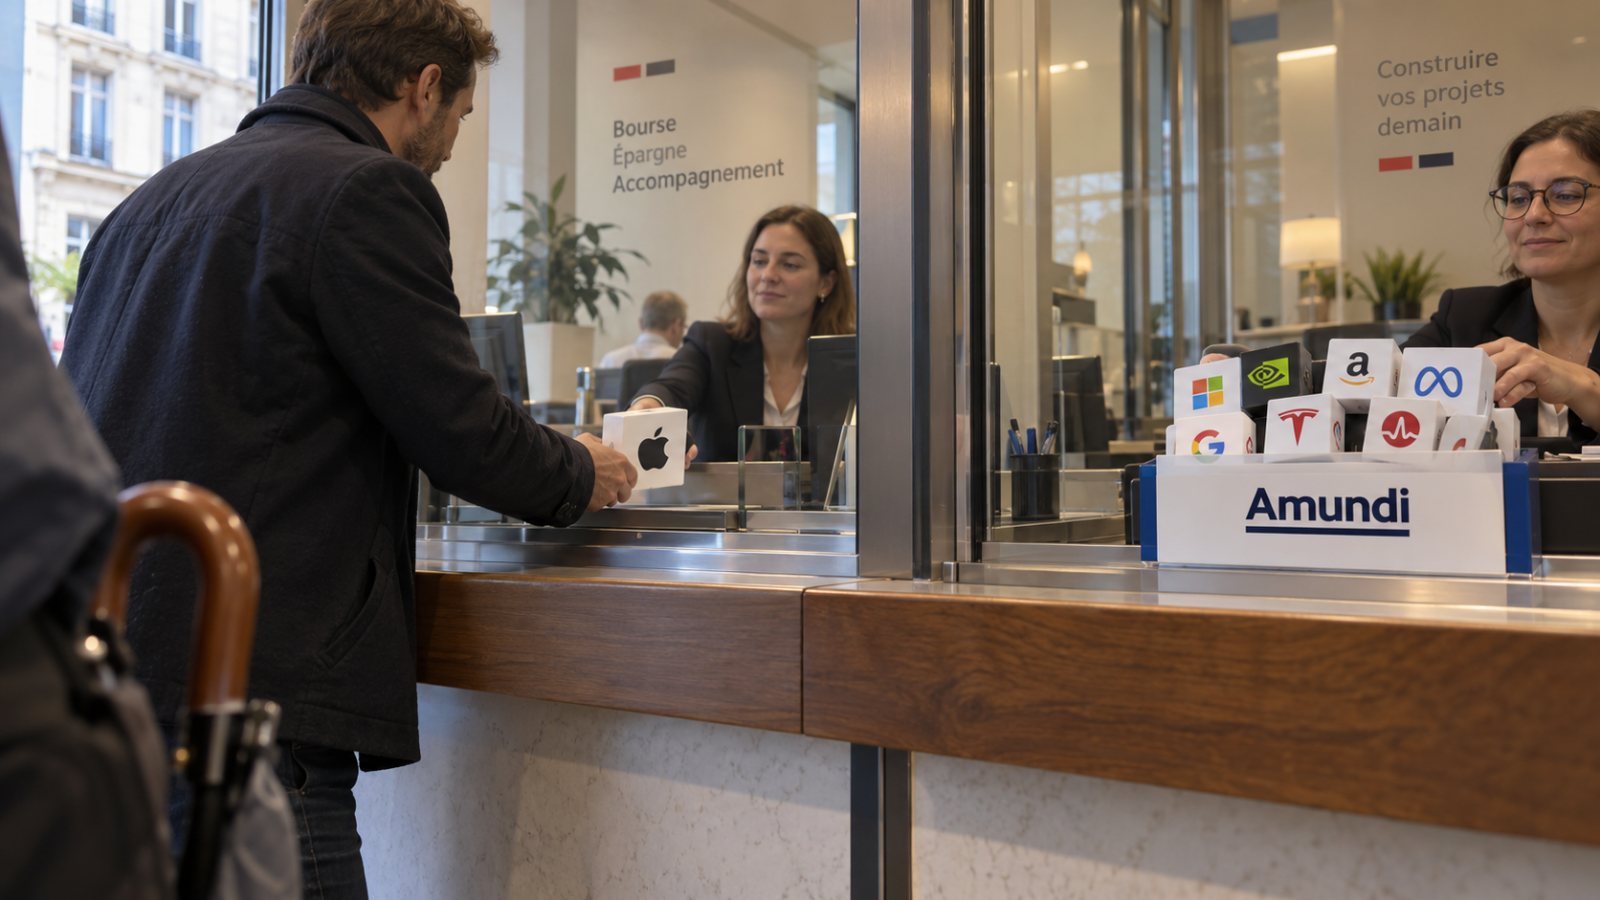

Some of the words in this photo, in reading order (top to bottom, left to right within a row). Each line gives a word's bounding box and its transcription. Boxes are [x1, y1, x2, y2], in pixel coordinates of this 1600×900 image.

[1377, 50, 1499, 79] Construire
[1377, 90, 1416, 107] vos
[1423, 79, 1505, 108] projets
[613, 117, 677, 138] Bourse
[1377, 112, 1462, 136] demain
[613, 143, 687, 169] Épargne
[612, 158, 784, 194] Accompagnement
[1346, 351, 1369, 377] a
[1191, 429, 1225, 463] G
[1245, 487, 1410, 523] Amundi
